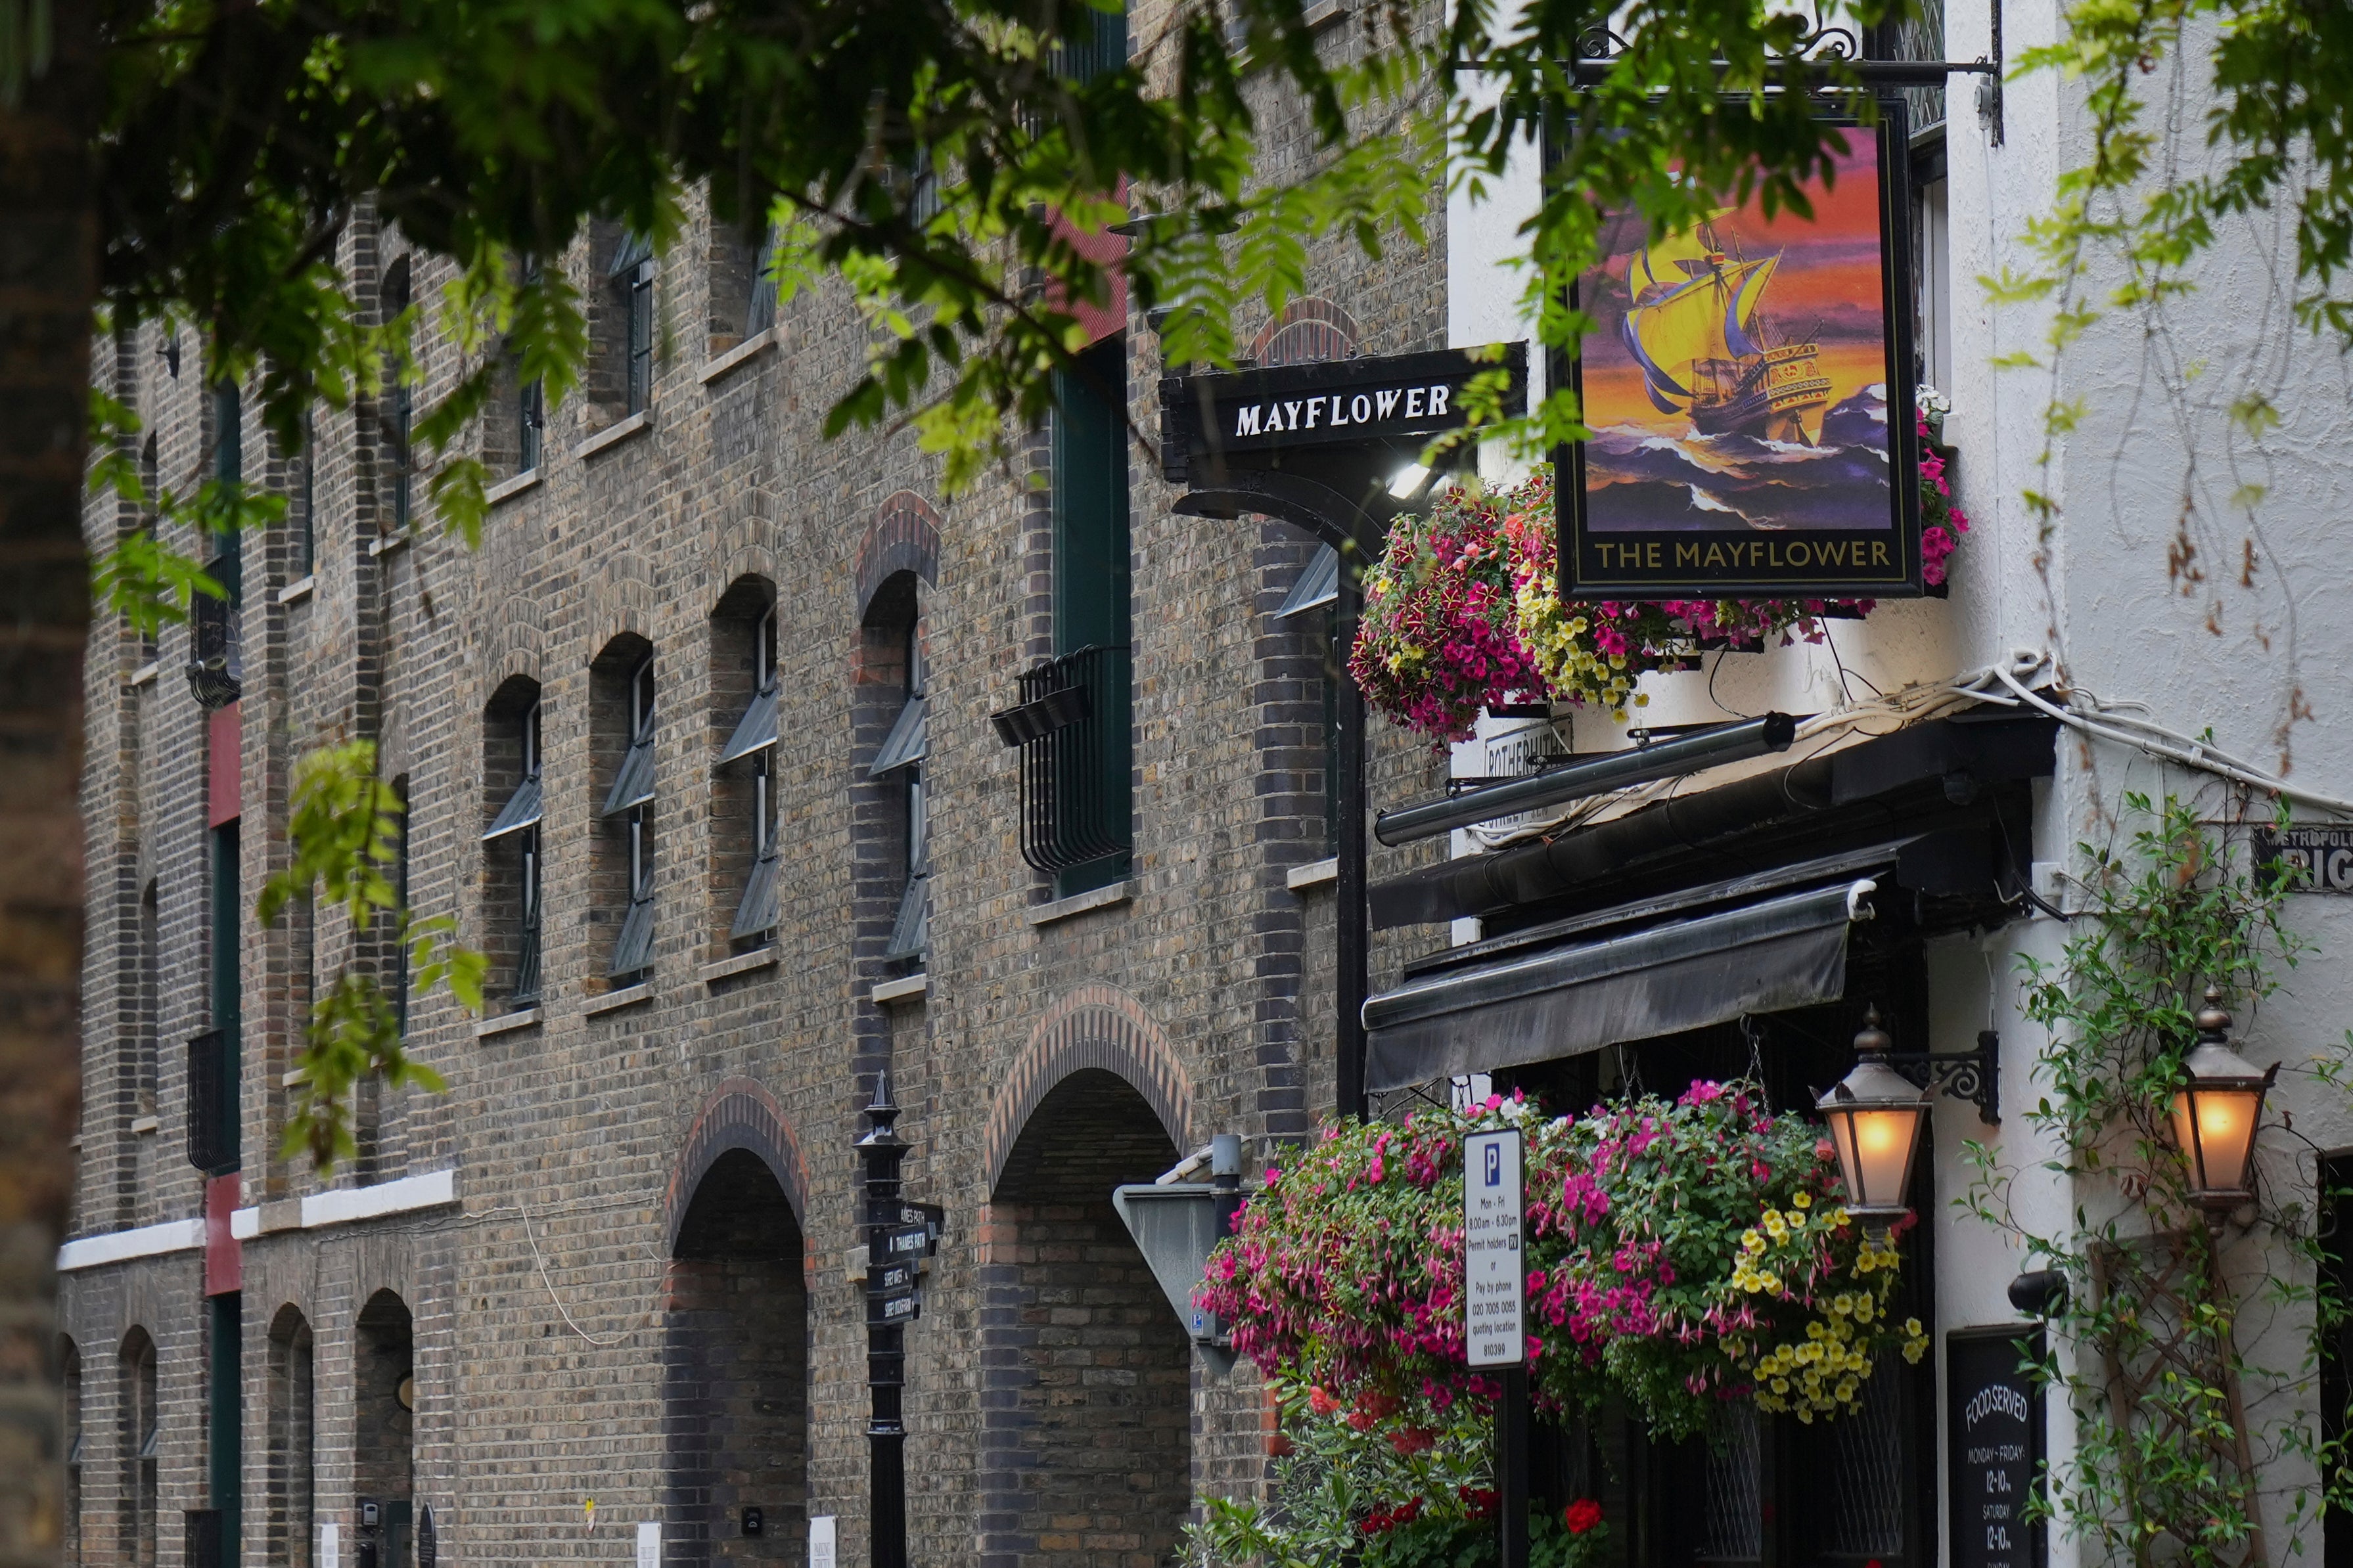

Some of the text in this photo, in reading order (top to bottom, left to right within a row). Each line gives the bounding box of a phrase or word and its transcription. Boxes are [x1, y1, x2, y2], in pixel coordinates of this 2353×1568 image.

[1236, 385, 1450, 437] MAYFLOWER
[1595, 541, 1890, 569] THE MAYFLOWER
[1480, 1198, 1492, 1209] Mon
[913, 1210, 925, 1224] PATH
[896, 1232, 925, 1251] THAMES PATH
[1469, 1238, 1485, 1251] Permit
[1487, 1237, 1507, 1250] holders
[1491, 1261, 1496, 1272] or
[1476, 1279, 1512, 1296] Pay by phone
[1473, 1299, 1516, 1316] 020 7005 0055
[1473, 1320, 1516, 1337] quoting location
[1484, 1343, 1505, 1357] 810399
[1966, 1384, 2027, 1432] FOOD SERVED
